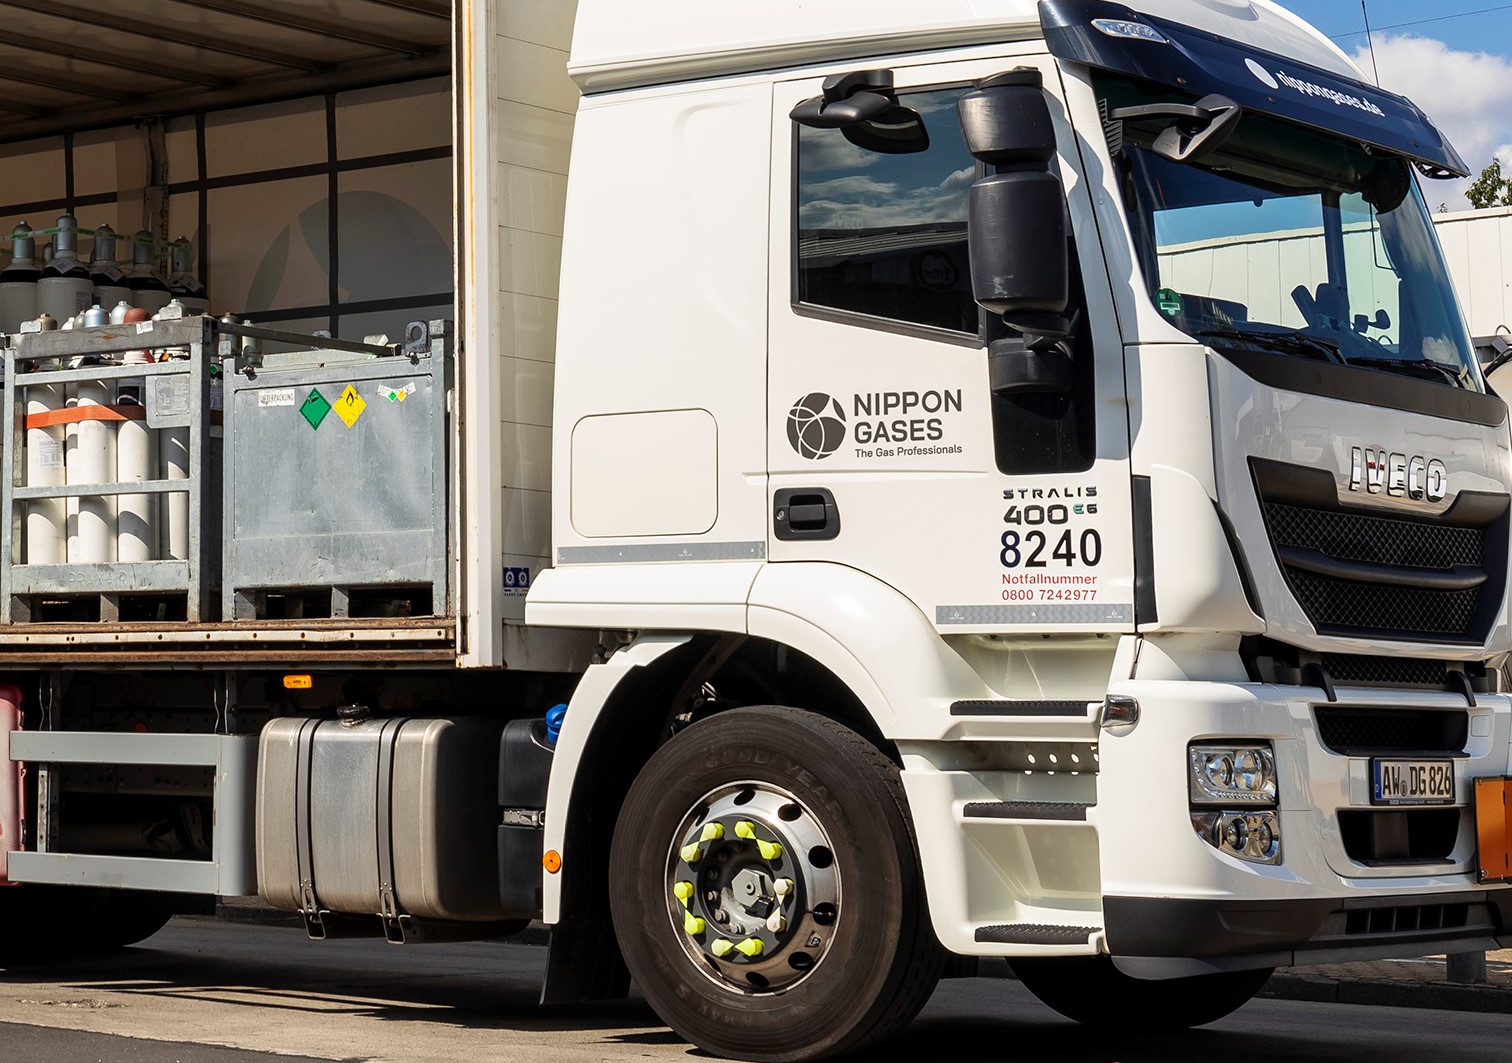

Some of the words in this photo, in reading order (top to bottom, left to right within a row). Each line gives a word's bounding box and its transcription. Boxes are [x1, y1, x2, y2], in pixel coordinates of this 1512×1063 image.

[1275, 70, 1385, 117] nippongases.de
[854, 389, 962, 416] NIPPON
[854, 418, 943, 444] GASES
[855, 449, 873, 458] The
[876, 448, 894, 457] Gas
[897, 444, 962, 456] Professionals
[1349, 446, 1447, 503] IVECO
[1003, 486, 1097, 499] STRALIS
[1003, 504, 1069, 525] 400
[1000, 528, 1102, 568] 8240
[1002, 573, 1097, 584] Notfallnummer
[1002, 589, 1033, 600] 0800
[1039, 589, 1097, 601] 7242977
[1382, 766, 1400, 795] AW
[1409, 766, 1426, 795] DG
[1429, 766, 1451, 795] 826
